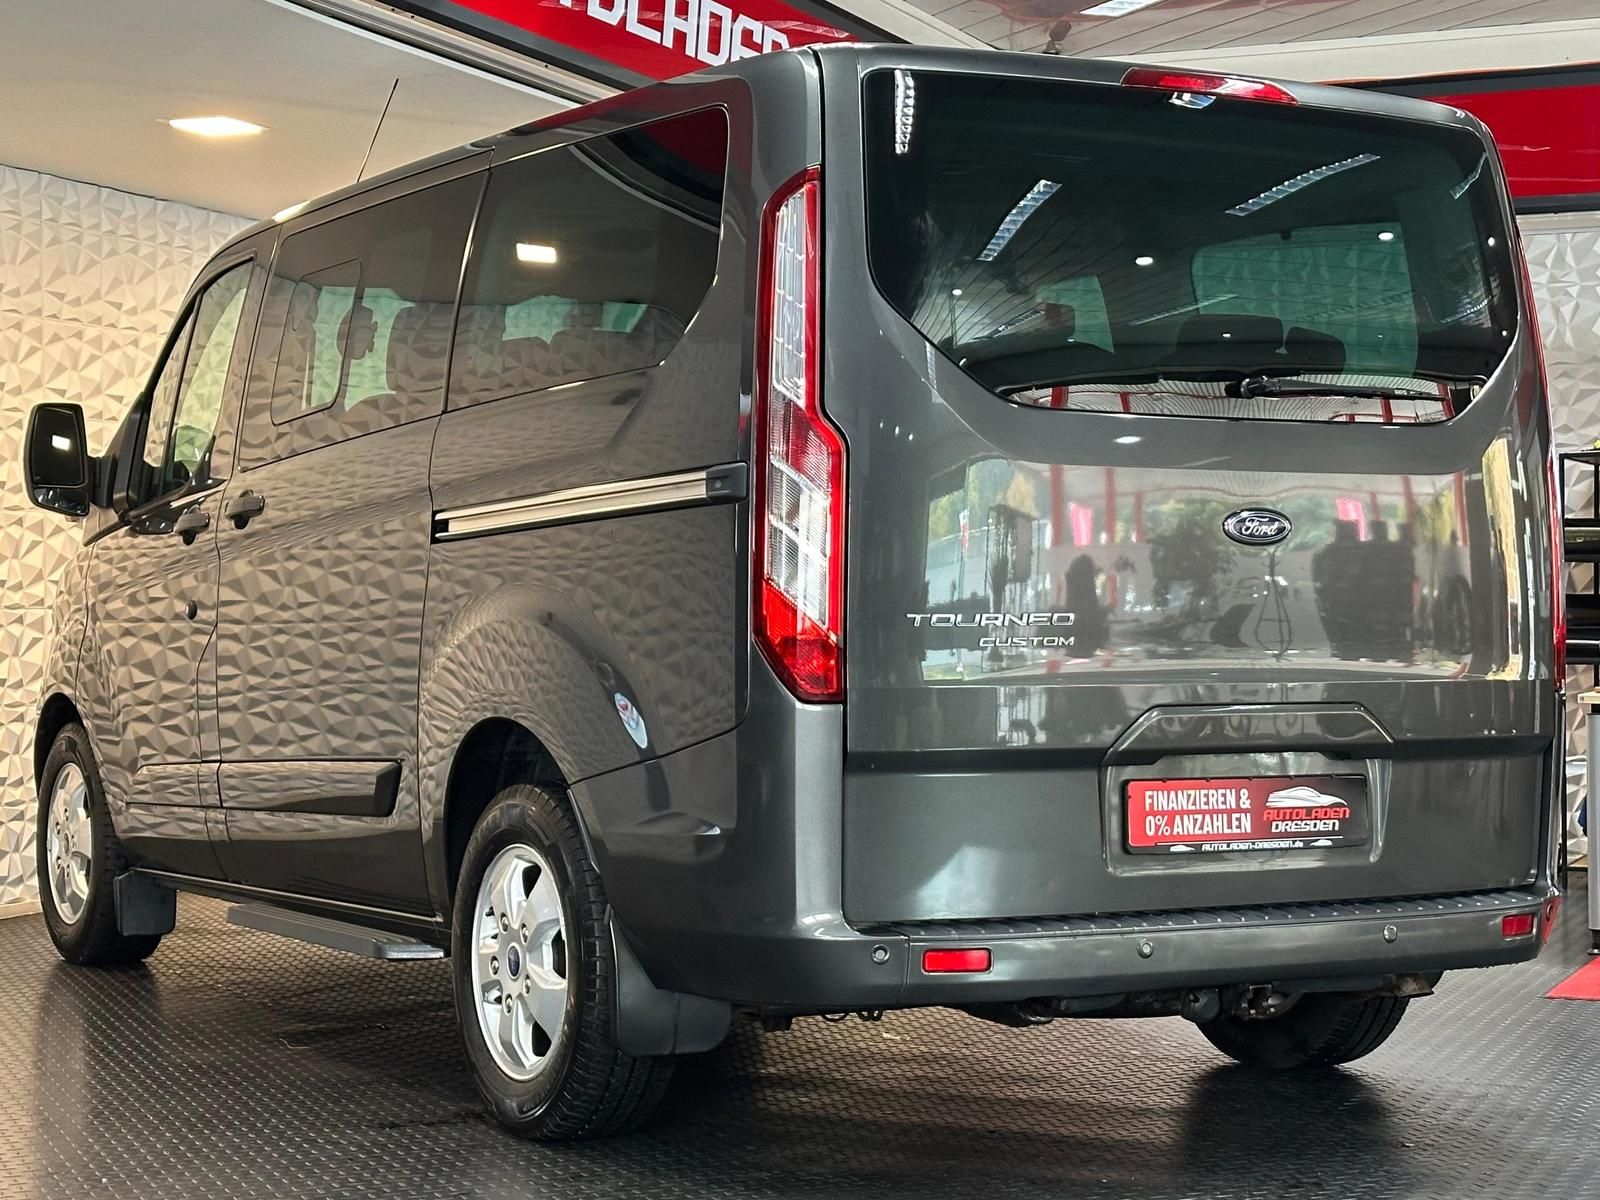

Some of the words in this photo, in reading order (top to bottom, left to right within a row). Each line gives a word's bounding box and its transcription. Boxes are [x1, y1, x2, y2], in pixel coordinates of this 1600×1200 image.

[1241, 516, 1279, 535] Ford
[906, 612, 1075, 627] TOURNEO
[978, 636, 1075, 647] CUSTOM
[1144, 789, 1236, 811] FINANZIEREN
[1239, 788, 1251, 808] &
[1263, 807, 1350, 821] AUTOLADEN
[1145, 815, 1171, 836] 0%
[1172, 812, 1251, 835] ANZAHLEN
[1271, 819, 1340, 833] DRESDEN
